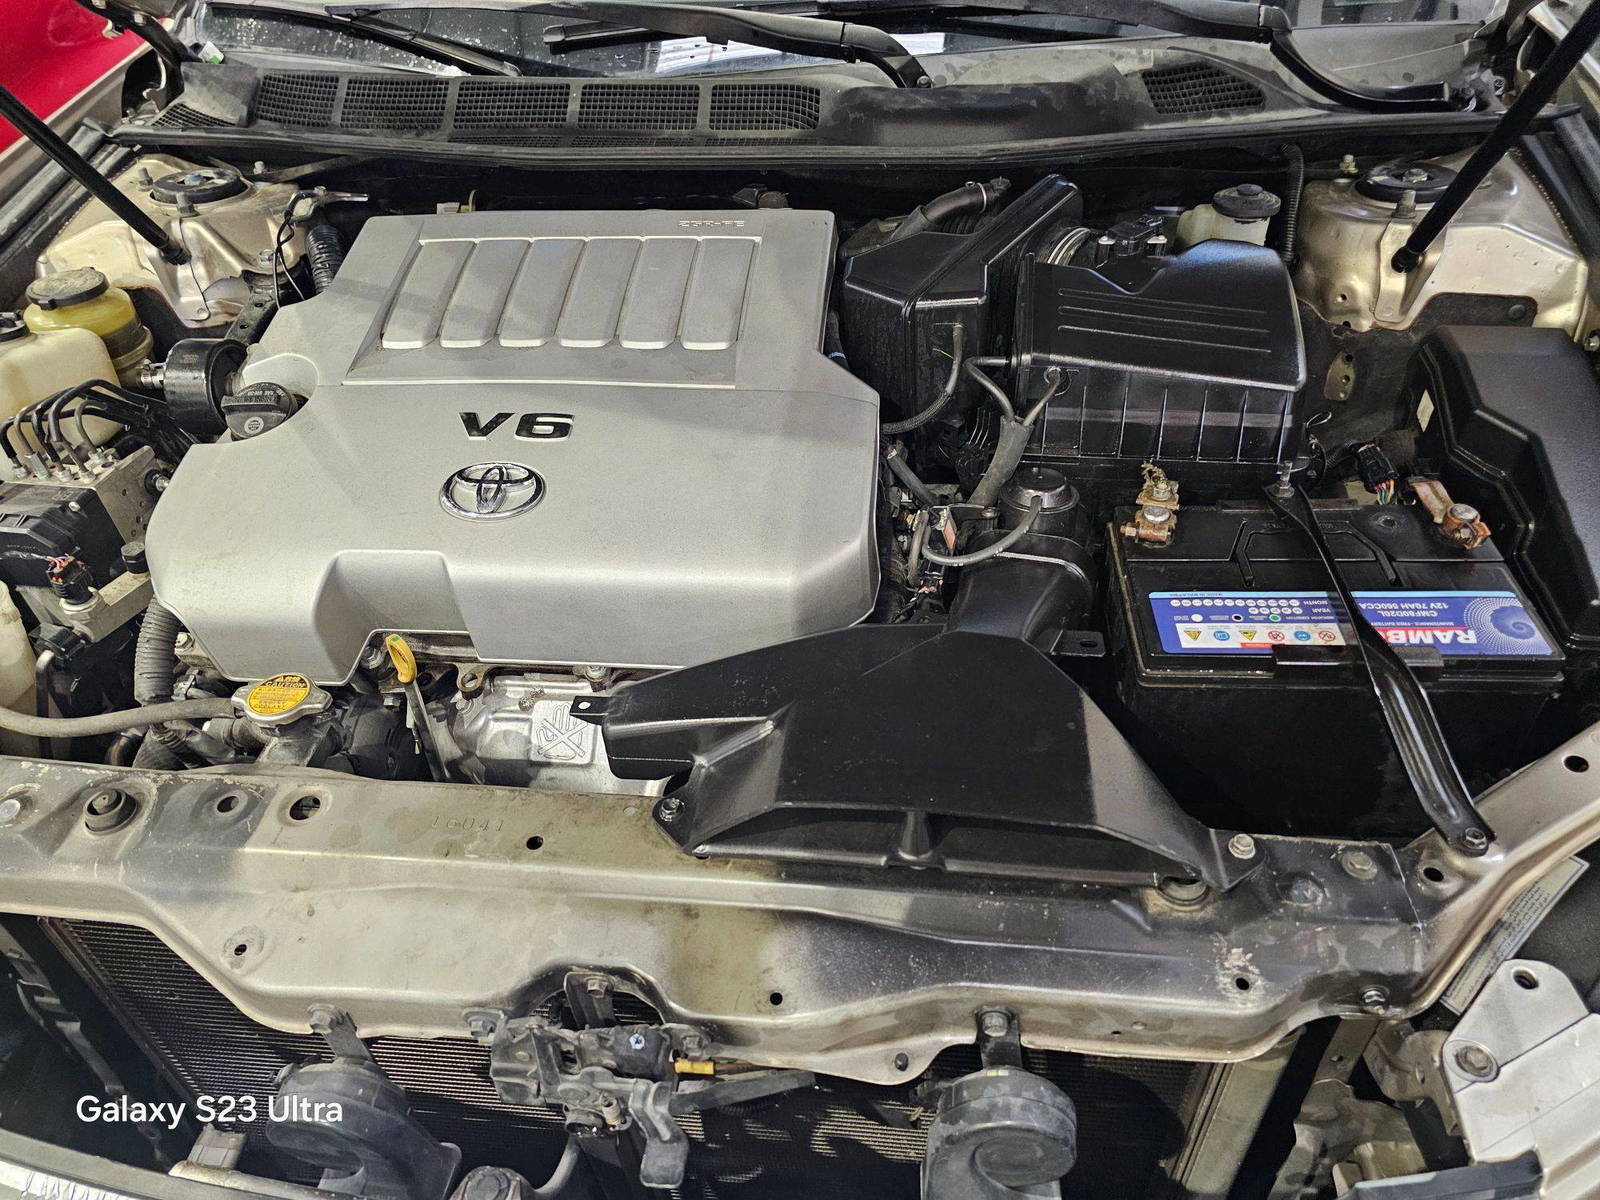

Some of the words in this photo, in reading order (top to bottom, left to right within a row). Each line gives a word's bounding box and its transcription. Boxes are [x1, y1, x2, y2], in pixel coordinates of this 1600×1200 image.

[458, 412, 575, 441] V6
[1401, 602, 1428, 610] 70AH
[1430, 602, 1449, 610] 12V
[1380, 629, 1478, 645] RAMB
